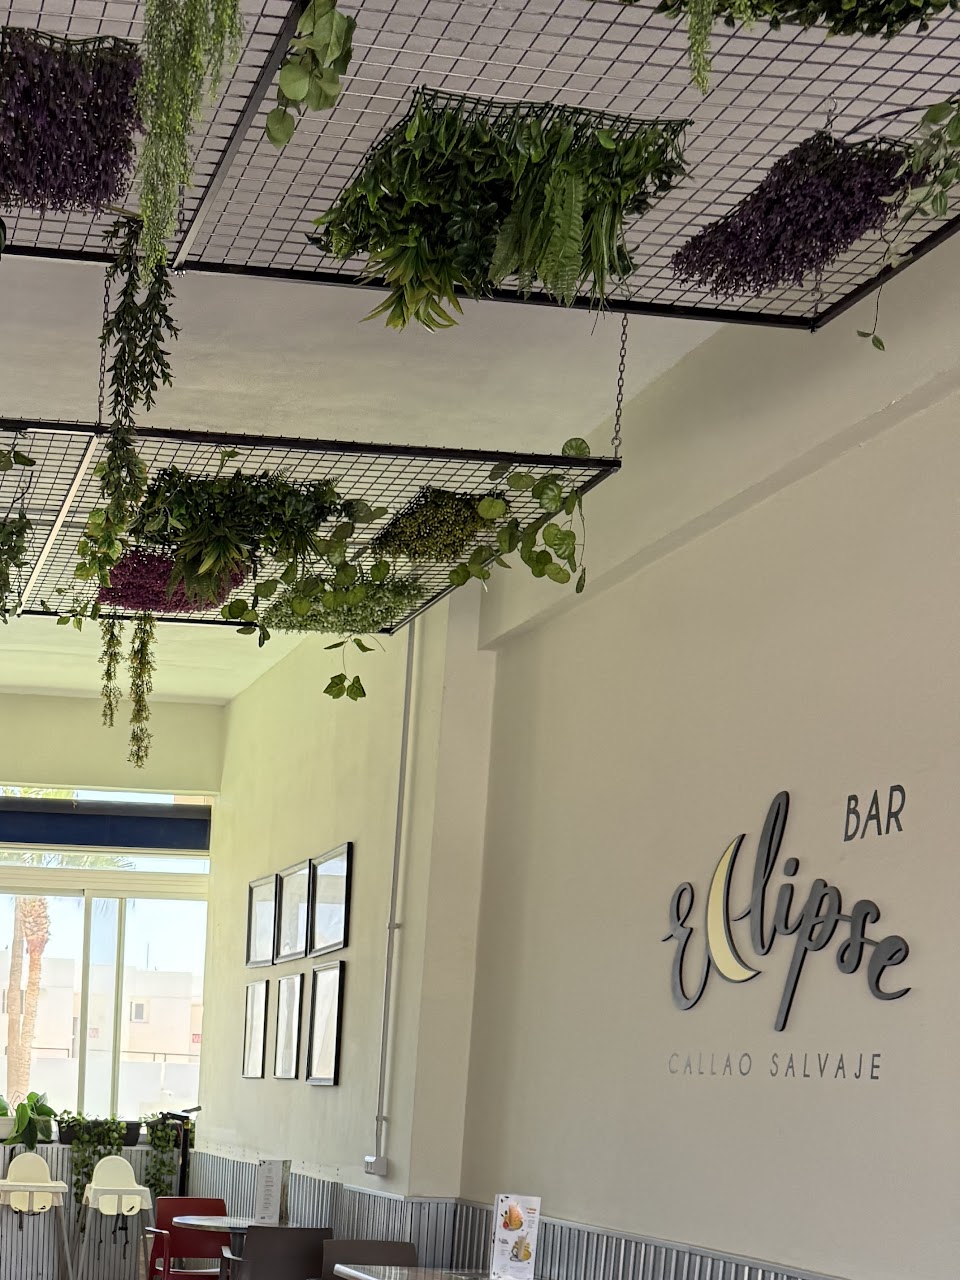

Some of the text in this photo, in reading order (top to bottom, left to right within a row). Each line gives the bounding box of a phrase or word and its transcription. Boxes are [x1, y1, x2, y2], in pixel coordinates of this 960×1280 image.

[843, 784, 907, 842] BAR
[668, 1052, 882, 1080] CALLAO SALVAJE
